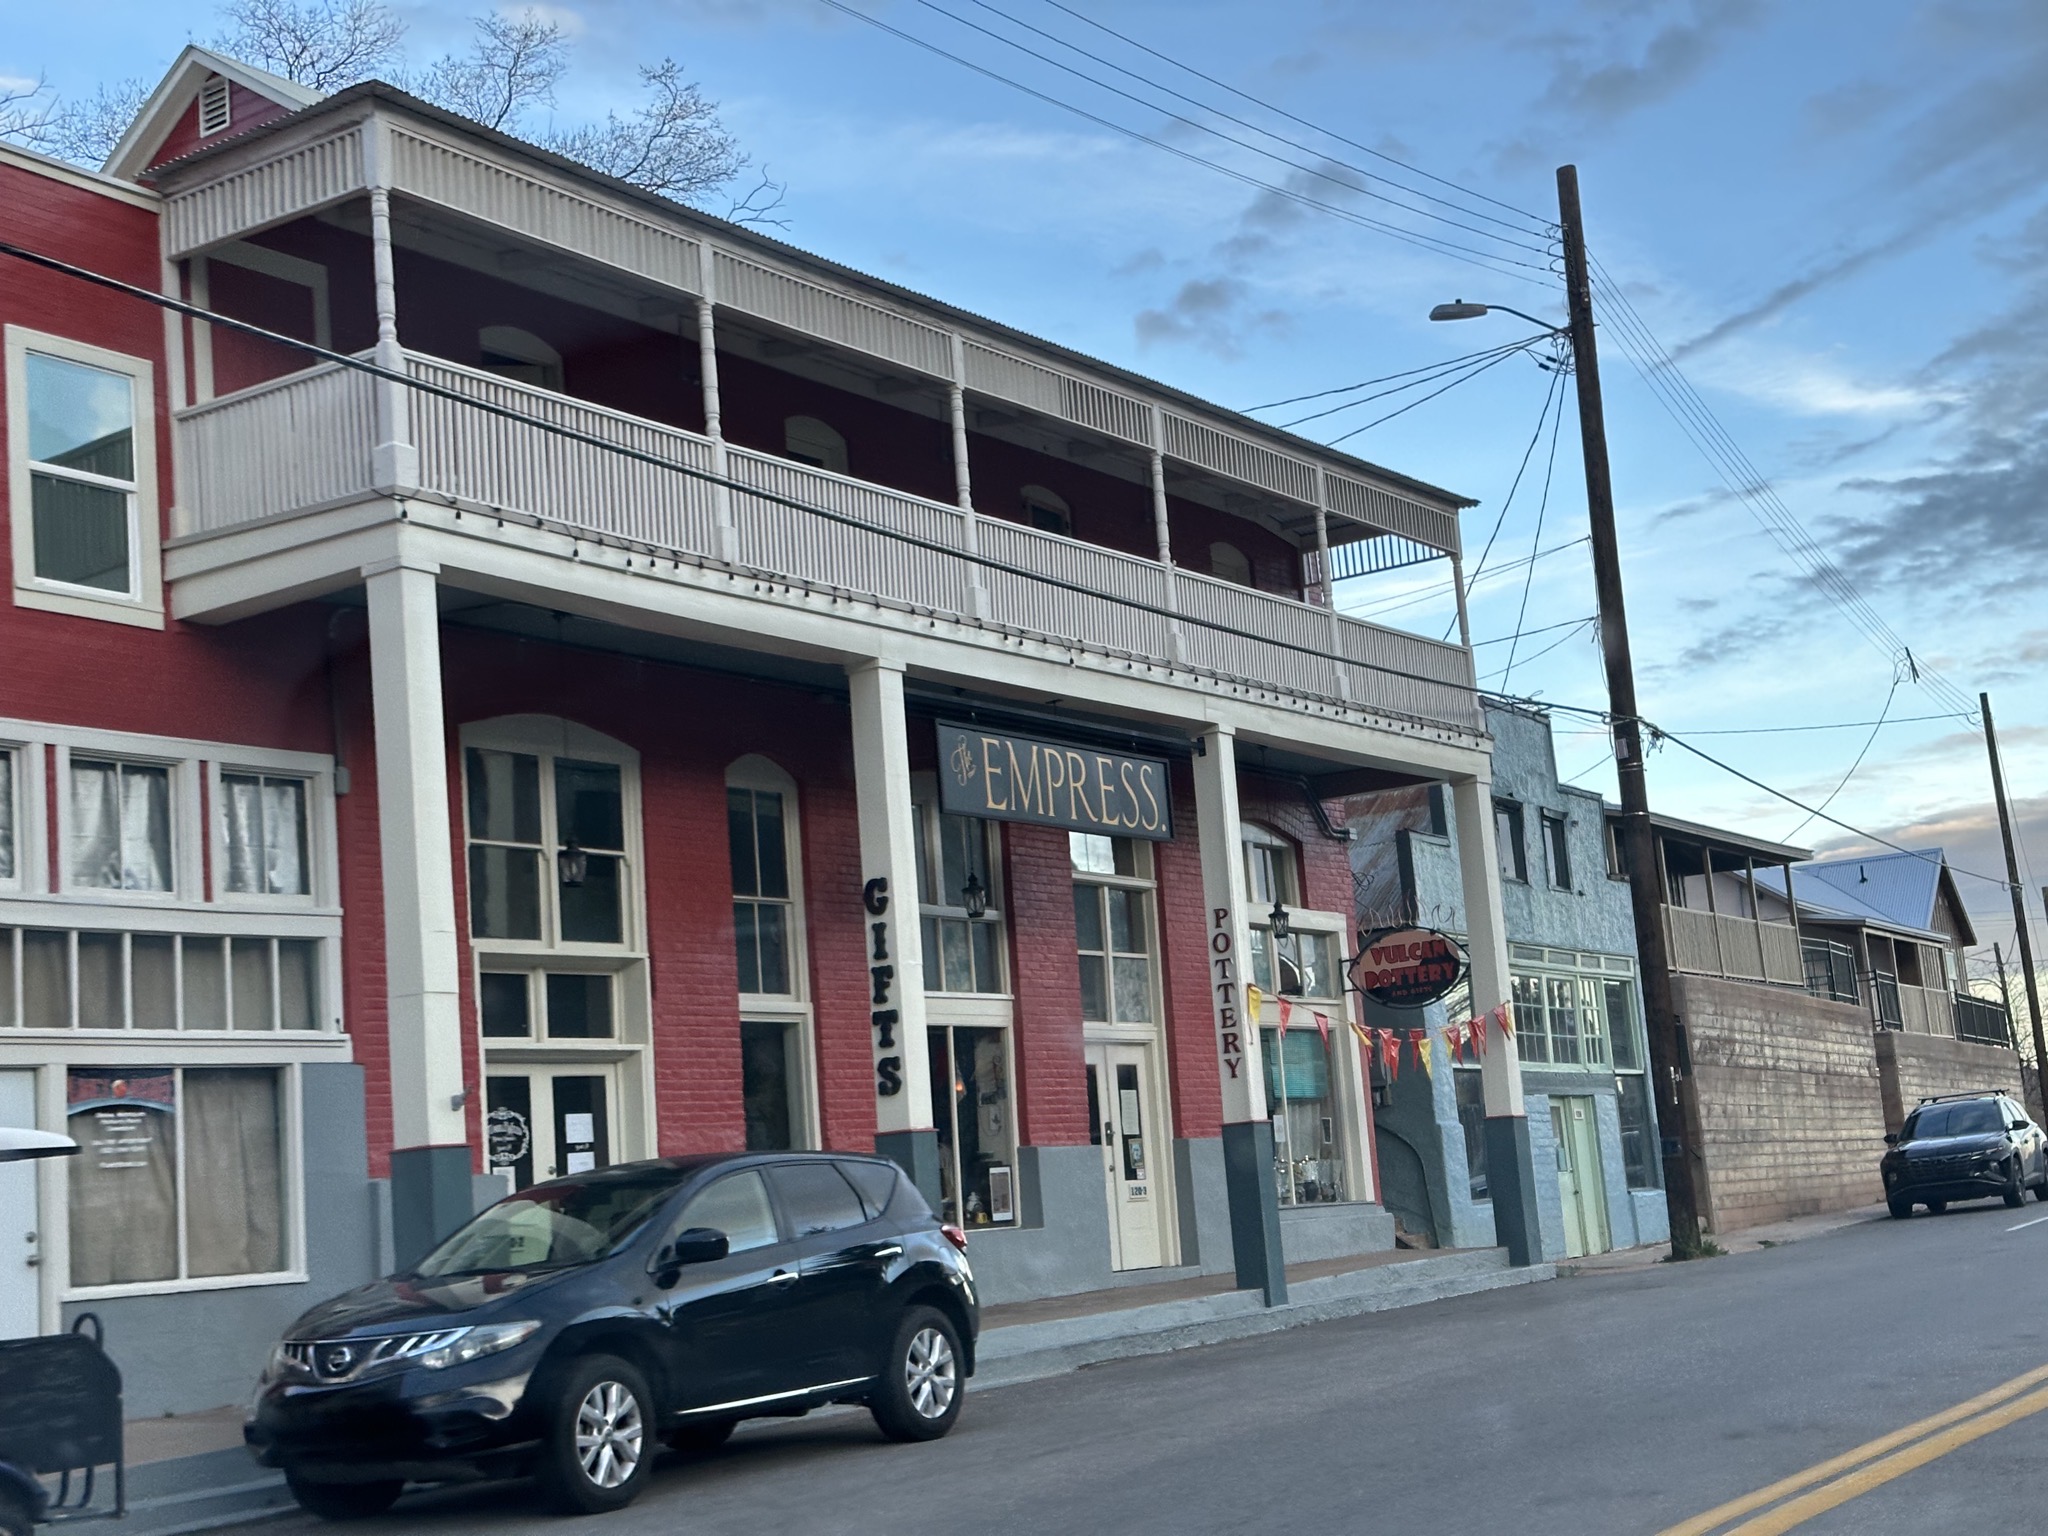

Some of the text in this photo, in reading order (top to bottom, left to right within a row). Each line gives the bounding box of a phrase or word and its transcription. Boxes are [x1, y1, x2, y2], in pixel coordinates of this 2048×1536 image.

[864, 877, 902, 1096] GIFTS
[1212, 908, 1242, 1079] POTTERY
[1364, 962, 1455, 990] POTTERY
[1370, 939, 1447, 966] VULCAN
